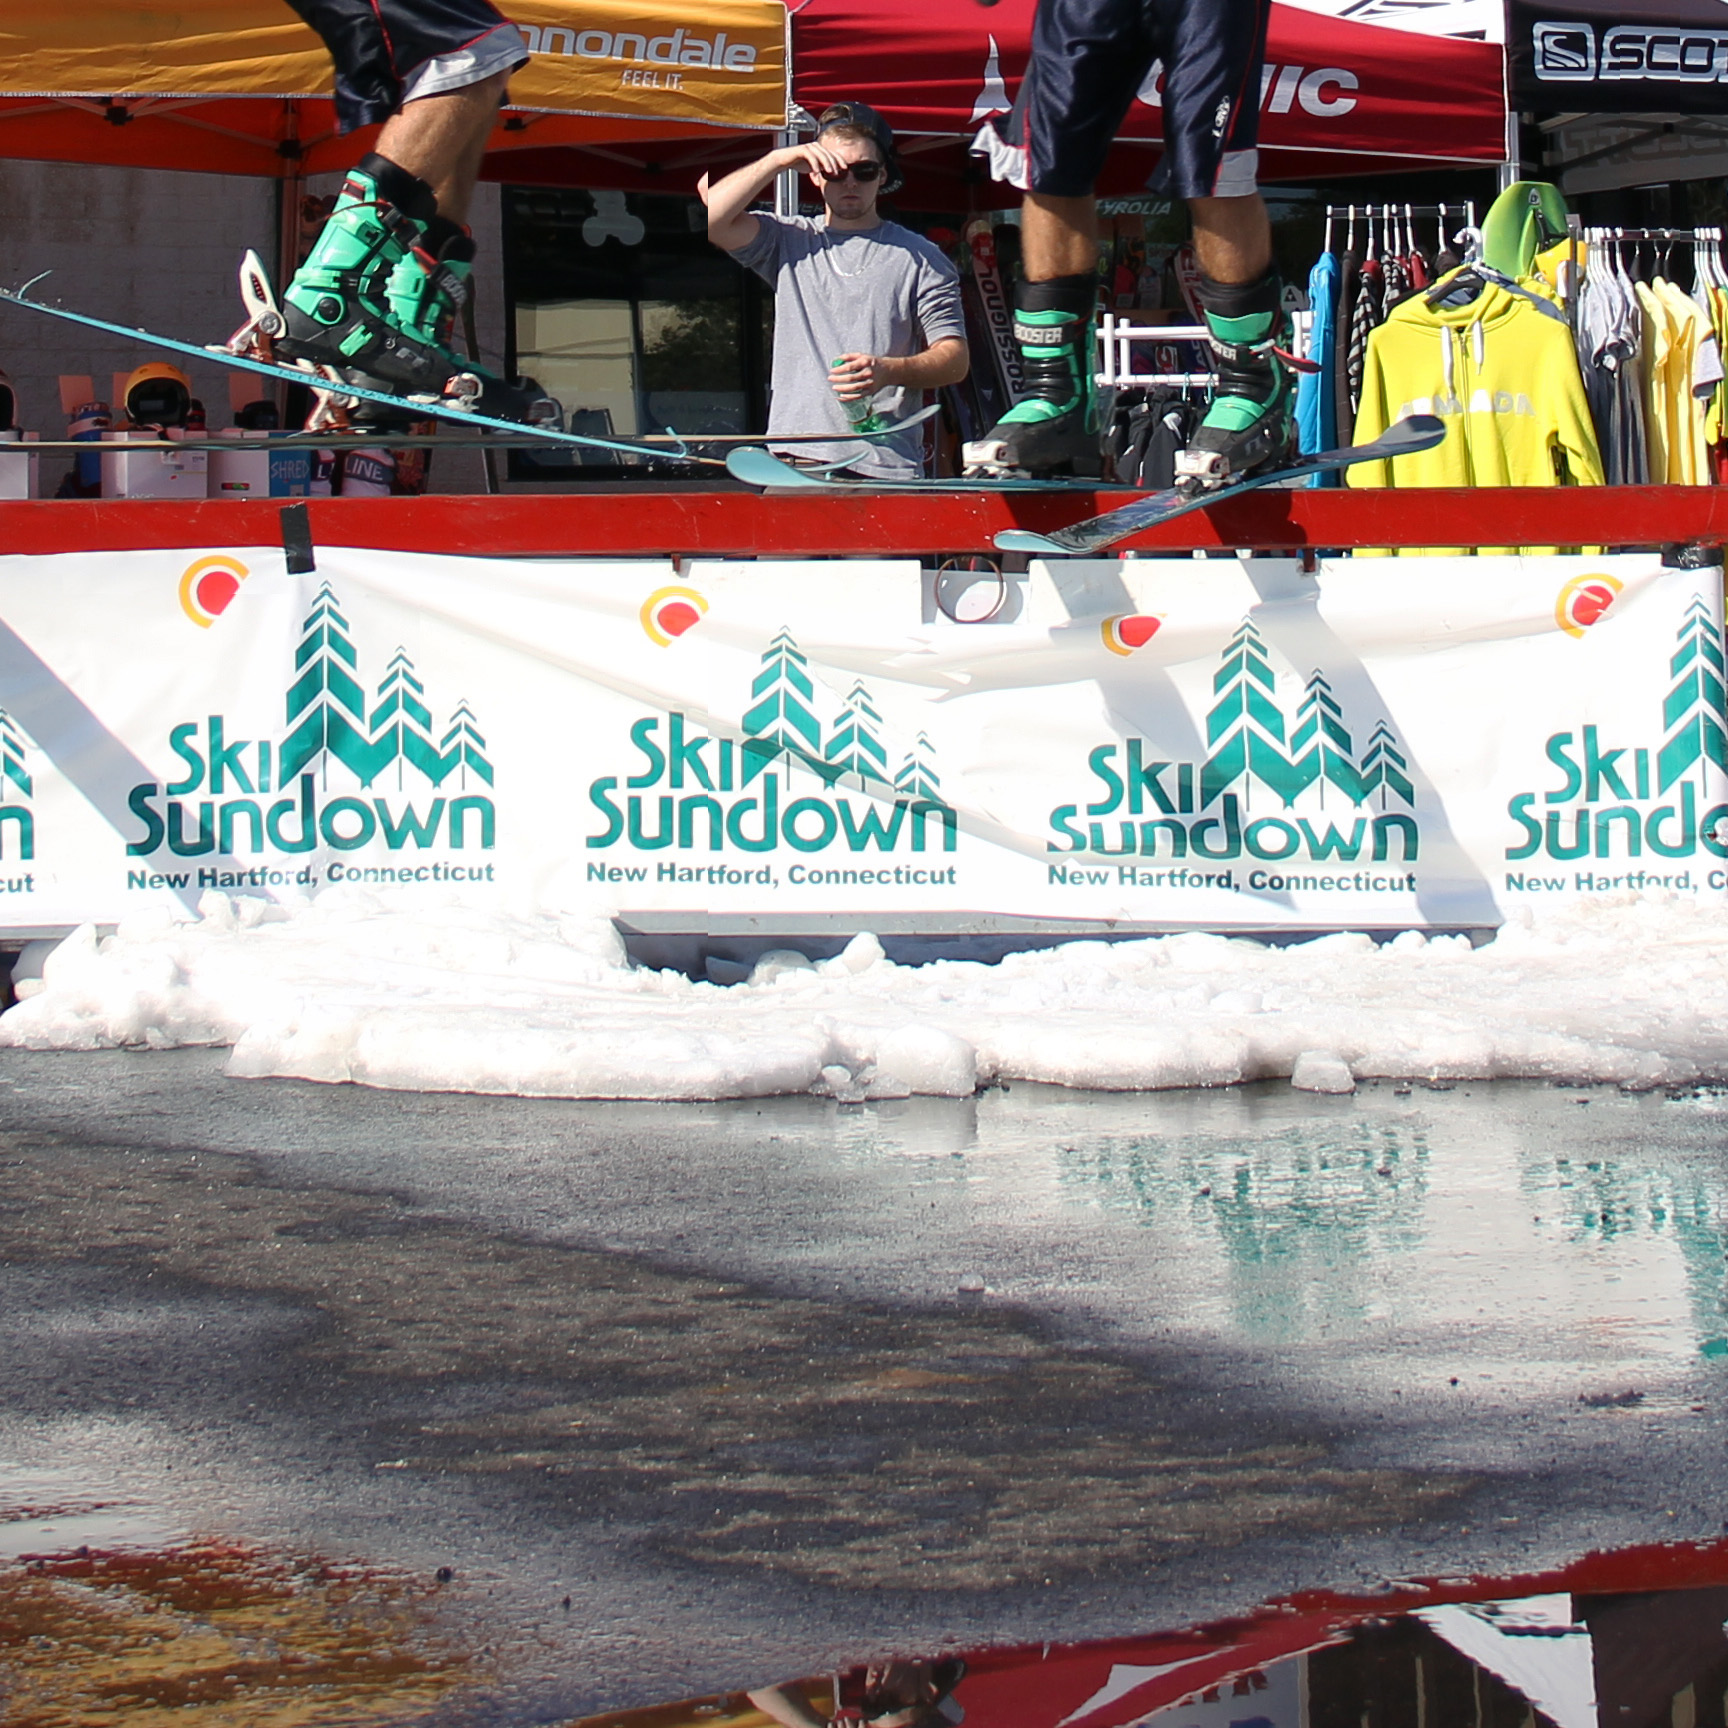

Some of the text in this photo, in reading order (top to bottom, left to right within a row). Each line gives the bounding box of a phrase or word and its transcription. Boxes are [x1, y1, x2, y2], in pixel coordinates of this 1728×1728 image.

[516, 23, 757, 72] nnondale
[622, 69, 683, 91] FEEL IT.
[977, 266, 1025, 395] ROSSIGNOL
[345, 459, 384, 480] LINE
[167, 714, 272, 797] Ski
[627, 711, 734, 792] Ski
[1087, 738, 1193, 816] Ski
[1544, 724, 1649, 804] Ski
[127, 773, 496, 857] Sundown
[585, 772, 957, 853] Sundown
[1047, 792, 1418, 862] Sundown
[127, 861, 495, 891] New Hartford, Connecticut
[587, 862, 957, 889] New Hartford, Connecticut
[1048, 865, 1417, 894] New Hartford, Connecticut
[1506, 872, 1566, 892] New
